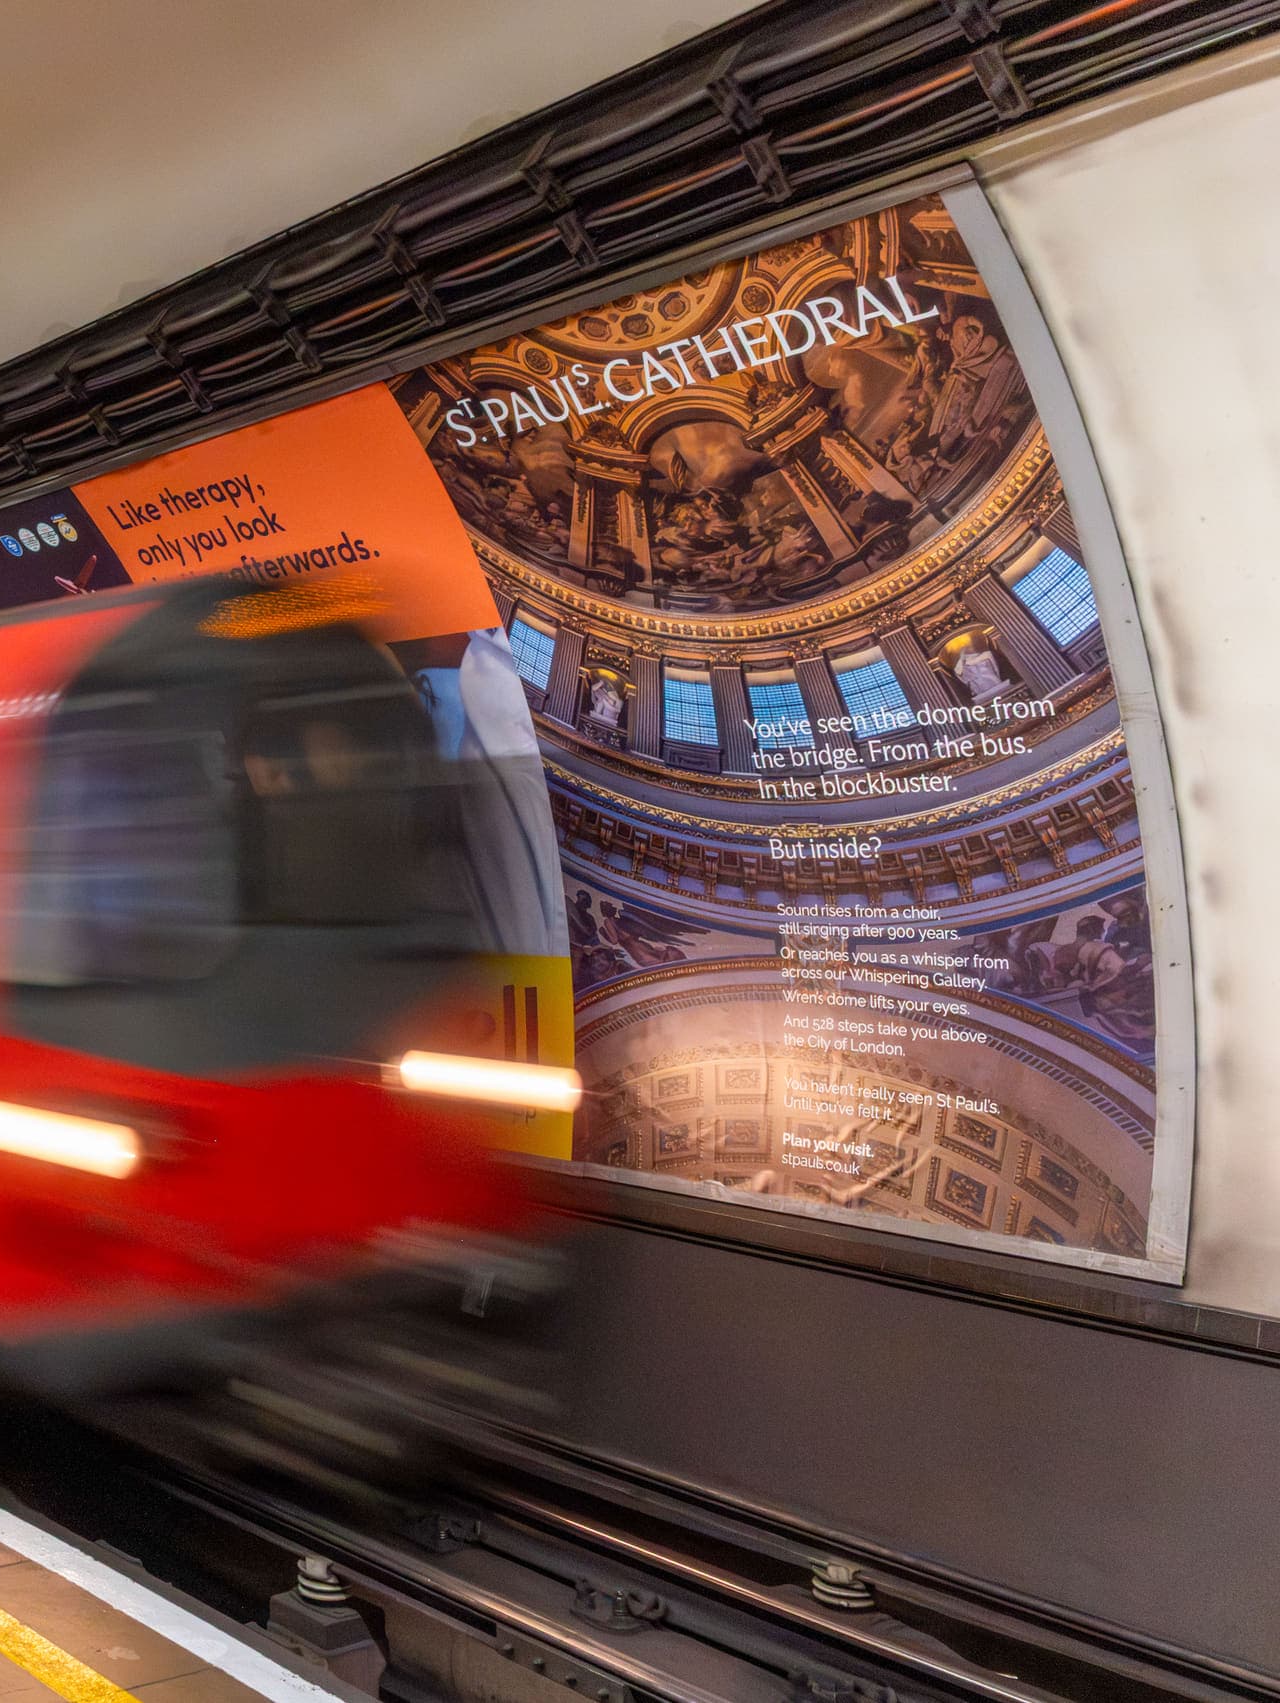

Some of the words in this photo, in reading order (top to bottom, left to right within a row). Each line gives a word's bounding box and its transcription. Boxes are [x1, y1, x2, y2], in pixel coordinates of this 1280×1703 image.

[603, 275, 939, 403] CATHEDRAL
[107, 500, 161, 530] Like
[159, 474, 265, 516] therapy,
[137, 533, 186, 566] only
[183, 527, 227, 562] you
[223, 505, 285, 543] look
[743, 716, 811, 740] You've
[818, 714, 867, 734] seen
[870, 706, 911, 731] the
[915, 702, 986, 727] dome
[991, 697, 1055, 722] from
[751, 748, 785, 770] the
[789, 744, 863, 770] bridge.
[868, 739, 928, 762] From
[933, 736, 974, 758] the
[981, 733, 1032, 756] bus.
[758, 778, 778, 799] In
[782, 776, 816, 797] the
[821, 772, 957, 797] blockbuster.
[769, 838, 805, 860] But
[810, 836, 881, 860] inside?
[777, 904, 818, 917] Sound
[821, 905, 851, 918] rises
[854, 905, 887, 919] from
[890, 908, 899, 919] a
[903, 906, 941, 921] choir,
[778, 923, 801, 935] still
[801, 924, 849, 939] singing
[852, 924, 884, 937] after
[888, 927, 915, 940] 900
[918, 928, 960, 942] years.
[780, 946, 796, 960] Or
[798, 948, 849, 962] reaches
[852, 952, 877, 966] you
[881, 953, 896, 964] as
[900, 954, 909, 965] a
[912, 953, 969, 970] whisper
[973, 955, 1009, 970] from
[782, 967, 822, 979] across
[825, 969, 846, 980] our
[850, 968, 929, 988] Whispering
[932, 973, 987, 993] Gallery.
[782, 990, 824, 1005] Wren's
[826, 993, 867, 1008] dome
[870, 994, 894, 1010] lifts
[897, 1000, 929, 1014] your
[932, 1002, 971, 1017] eyes.
[784, 1016, 809, 1029] And
[812, 1018, 834, 1032] 528
[838, 1020, 874, 1036] steps
[878, 1022, 908, 1037] take
[910, 1027, 937, 1041] you
[941, 1027, 988, 1044] above
[784, 1034, 805, 1047] the
[808, 1034, 830, 1052] City
[834, 1037, 848, 1051] of
[850, 1039, 906, 1057] London.
[784, 1076, 808, 1091] You
[810, 1080, 854, 1097] haven't
[858, 1085, 895, 1105] really
[898, 1091, 933, 1106] seen
[936, 1093, 952, 1109] St
[955, 1096, 1001, 1114] Paul's.
[784, 1095, 812, 1109] Until
[814, 1099, 854, 1115] you've
[858, 1103, 879, 1120] felt
[883, 1107, 894, 1121] it.
[782, 1132, 811, 1147] Plan
[813, 1138, 840, 1153] your
[842, 1140, 874, 1158] visit.
[782, 1153, 860, 1176] stpauls.co.uk
